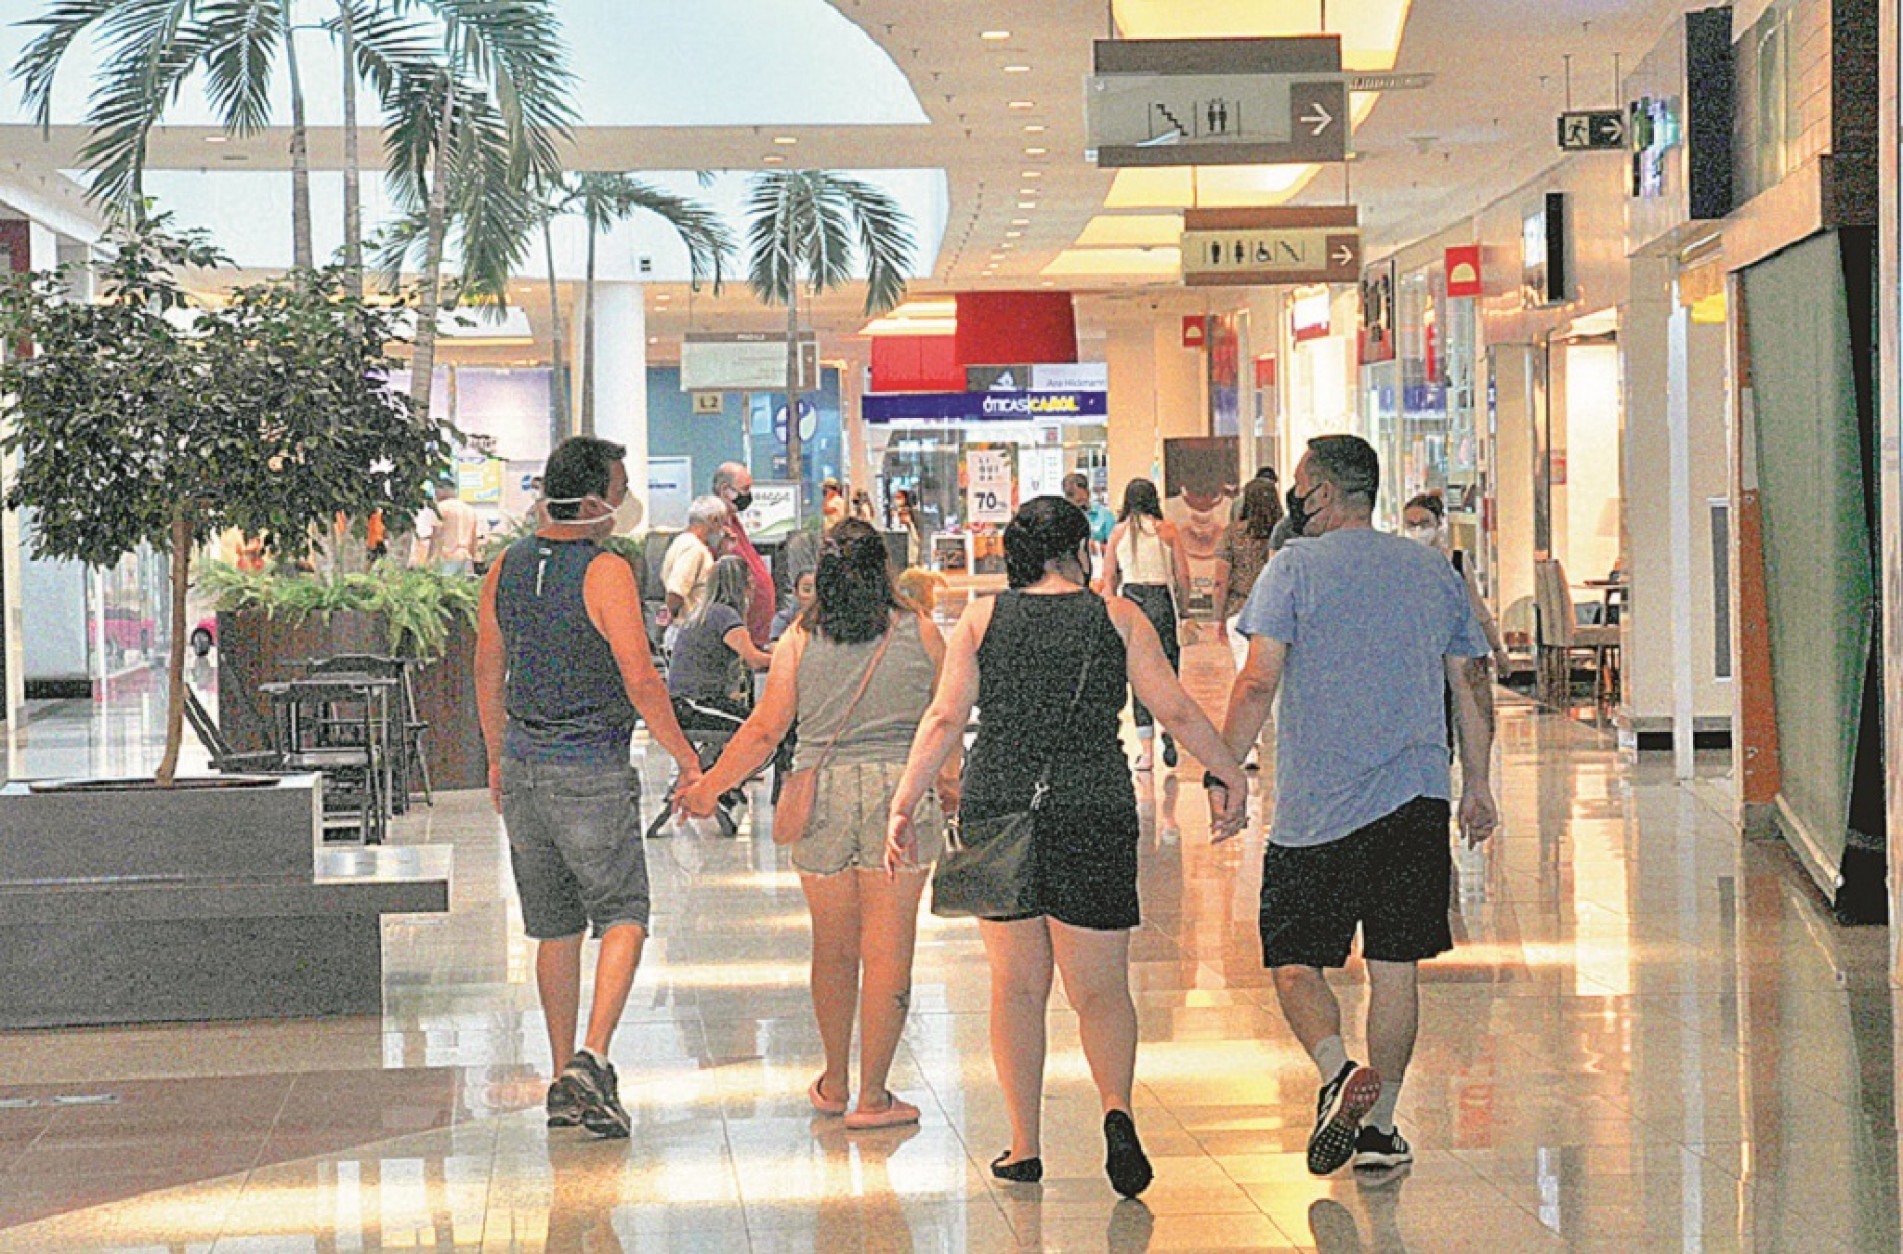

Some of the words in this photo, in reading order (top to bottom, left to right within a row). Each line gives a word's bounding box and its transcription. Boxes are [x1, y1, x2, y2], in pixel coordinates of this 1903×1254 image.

[699, 396, 719, 408] L2
[982, 394, 1028, 413] ÓTICAS
[1029, 395, 1080, 412] CAROL
[974, 491, 997, 510] 70
